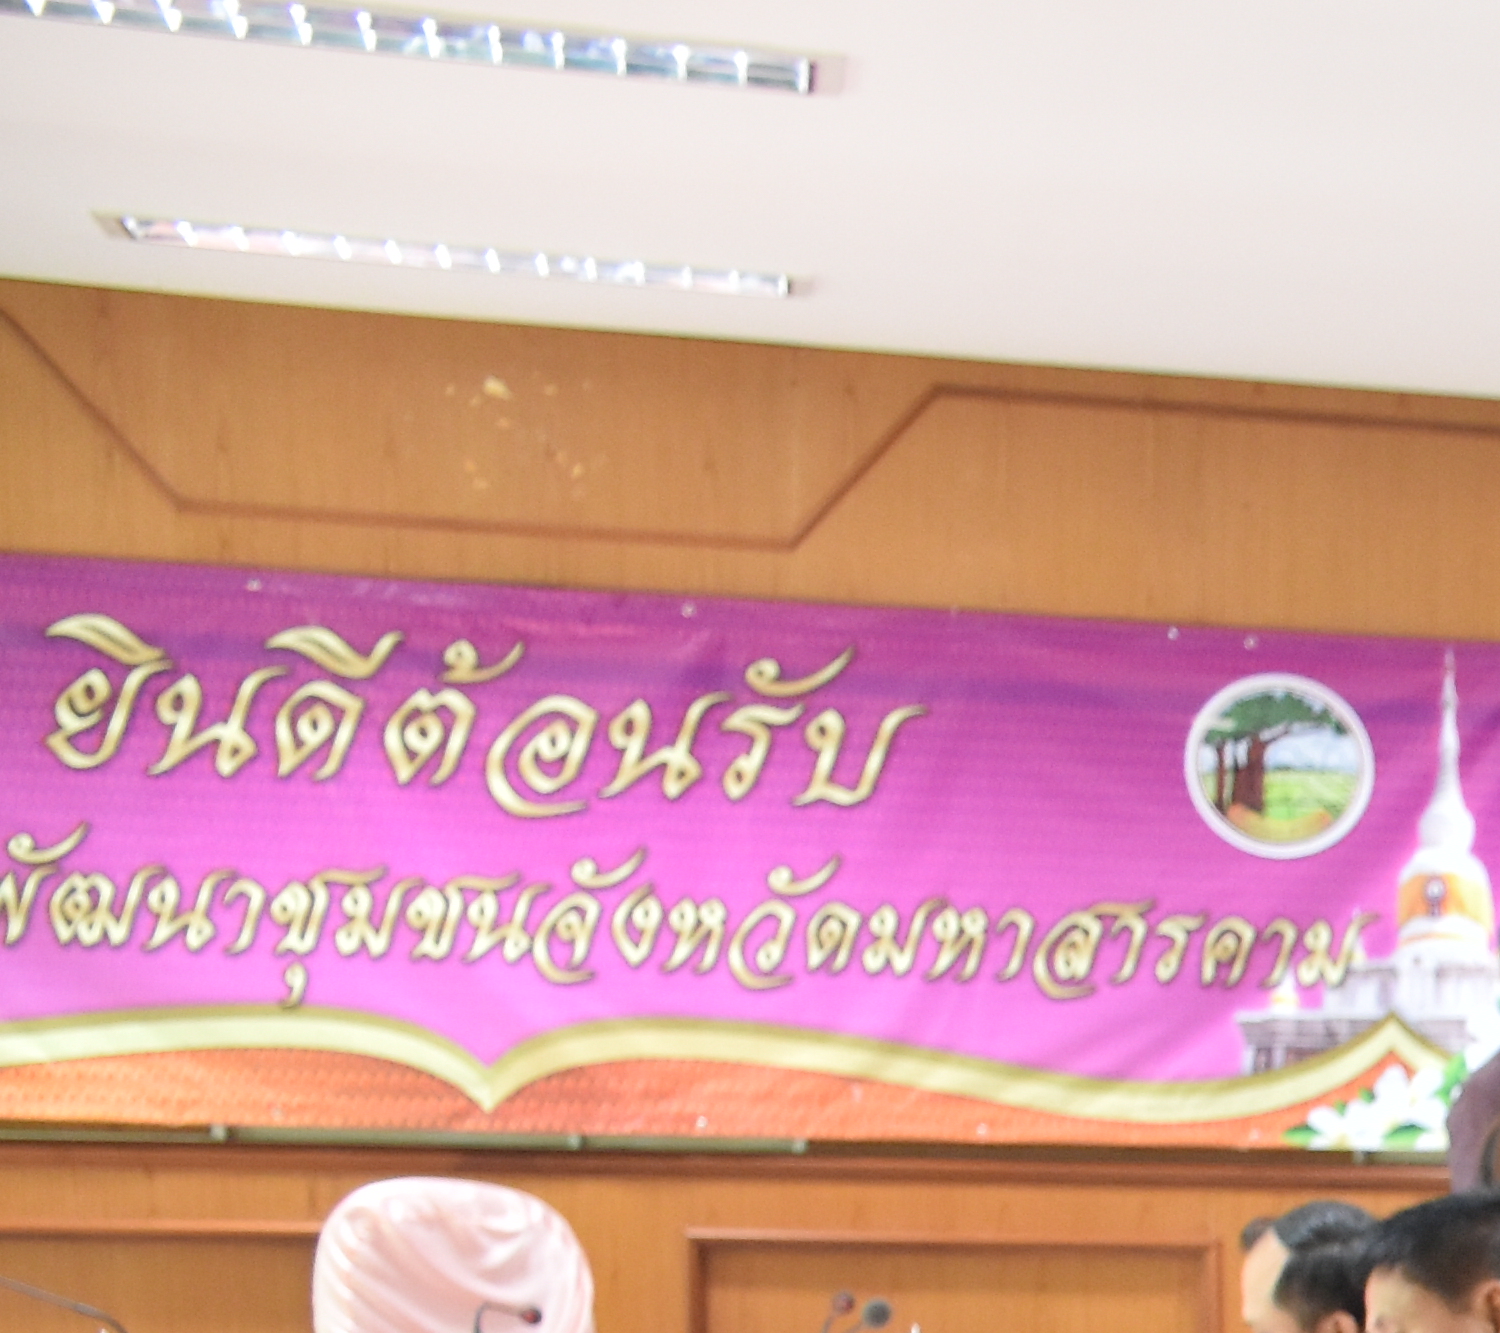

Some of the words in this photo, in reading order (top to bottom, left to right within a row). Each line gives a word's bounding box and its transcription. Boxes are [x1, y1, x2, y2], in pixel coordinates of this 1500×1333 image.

[45, 612, 928, 817] ยินดีต้อนรับ
